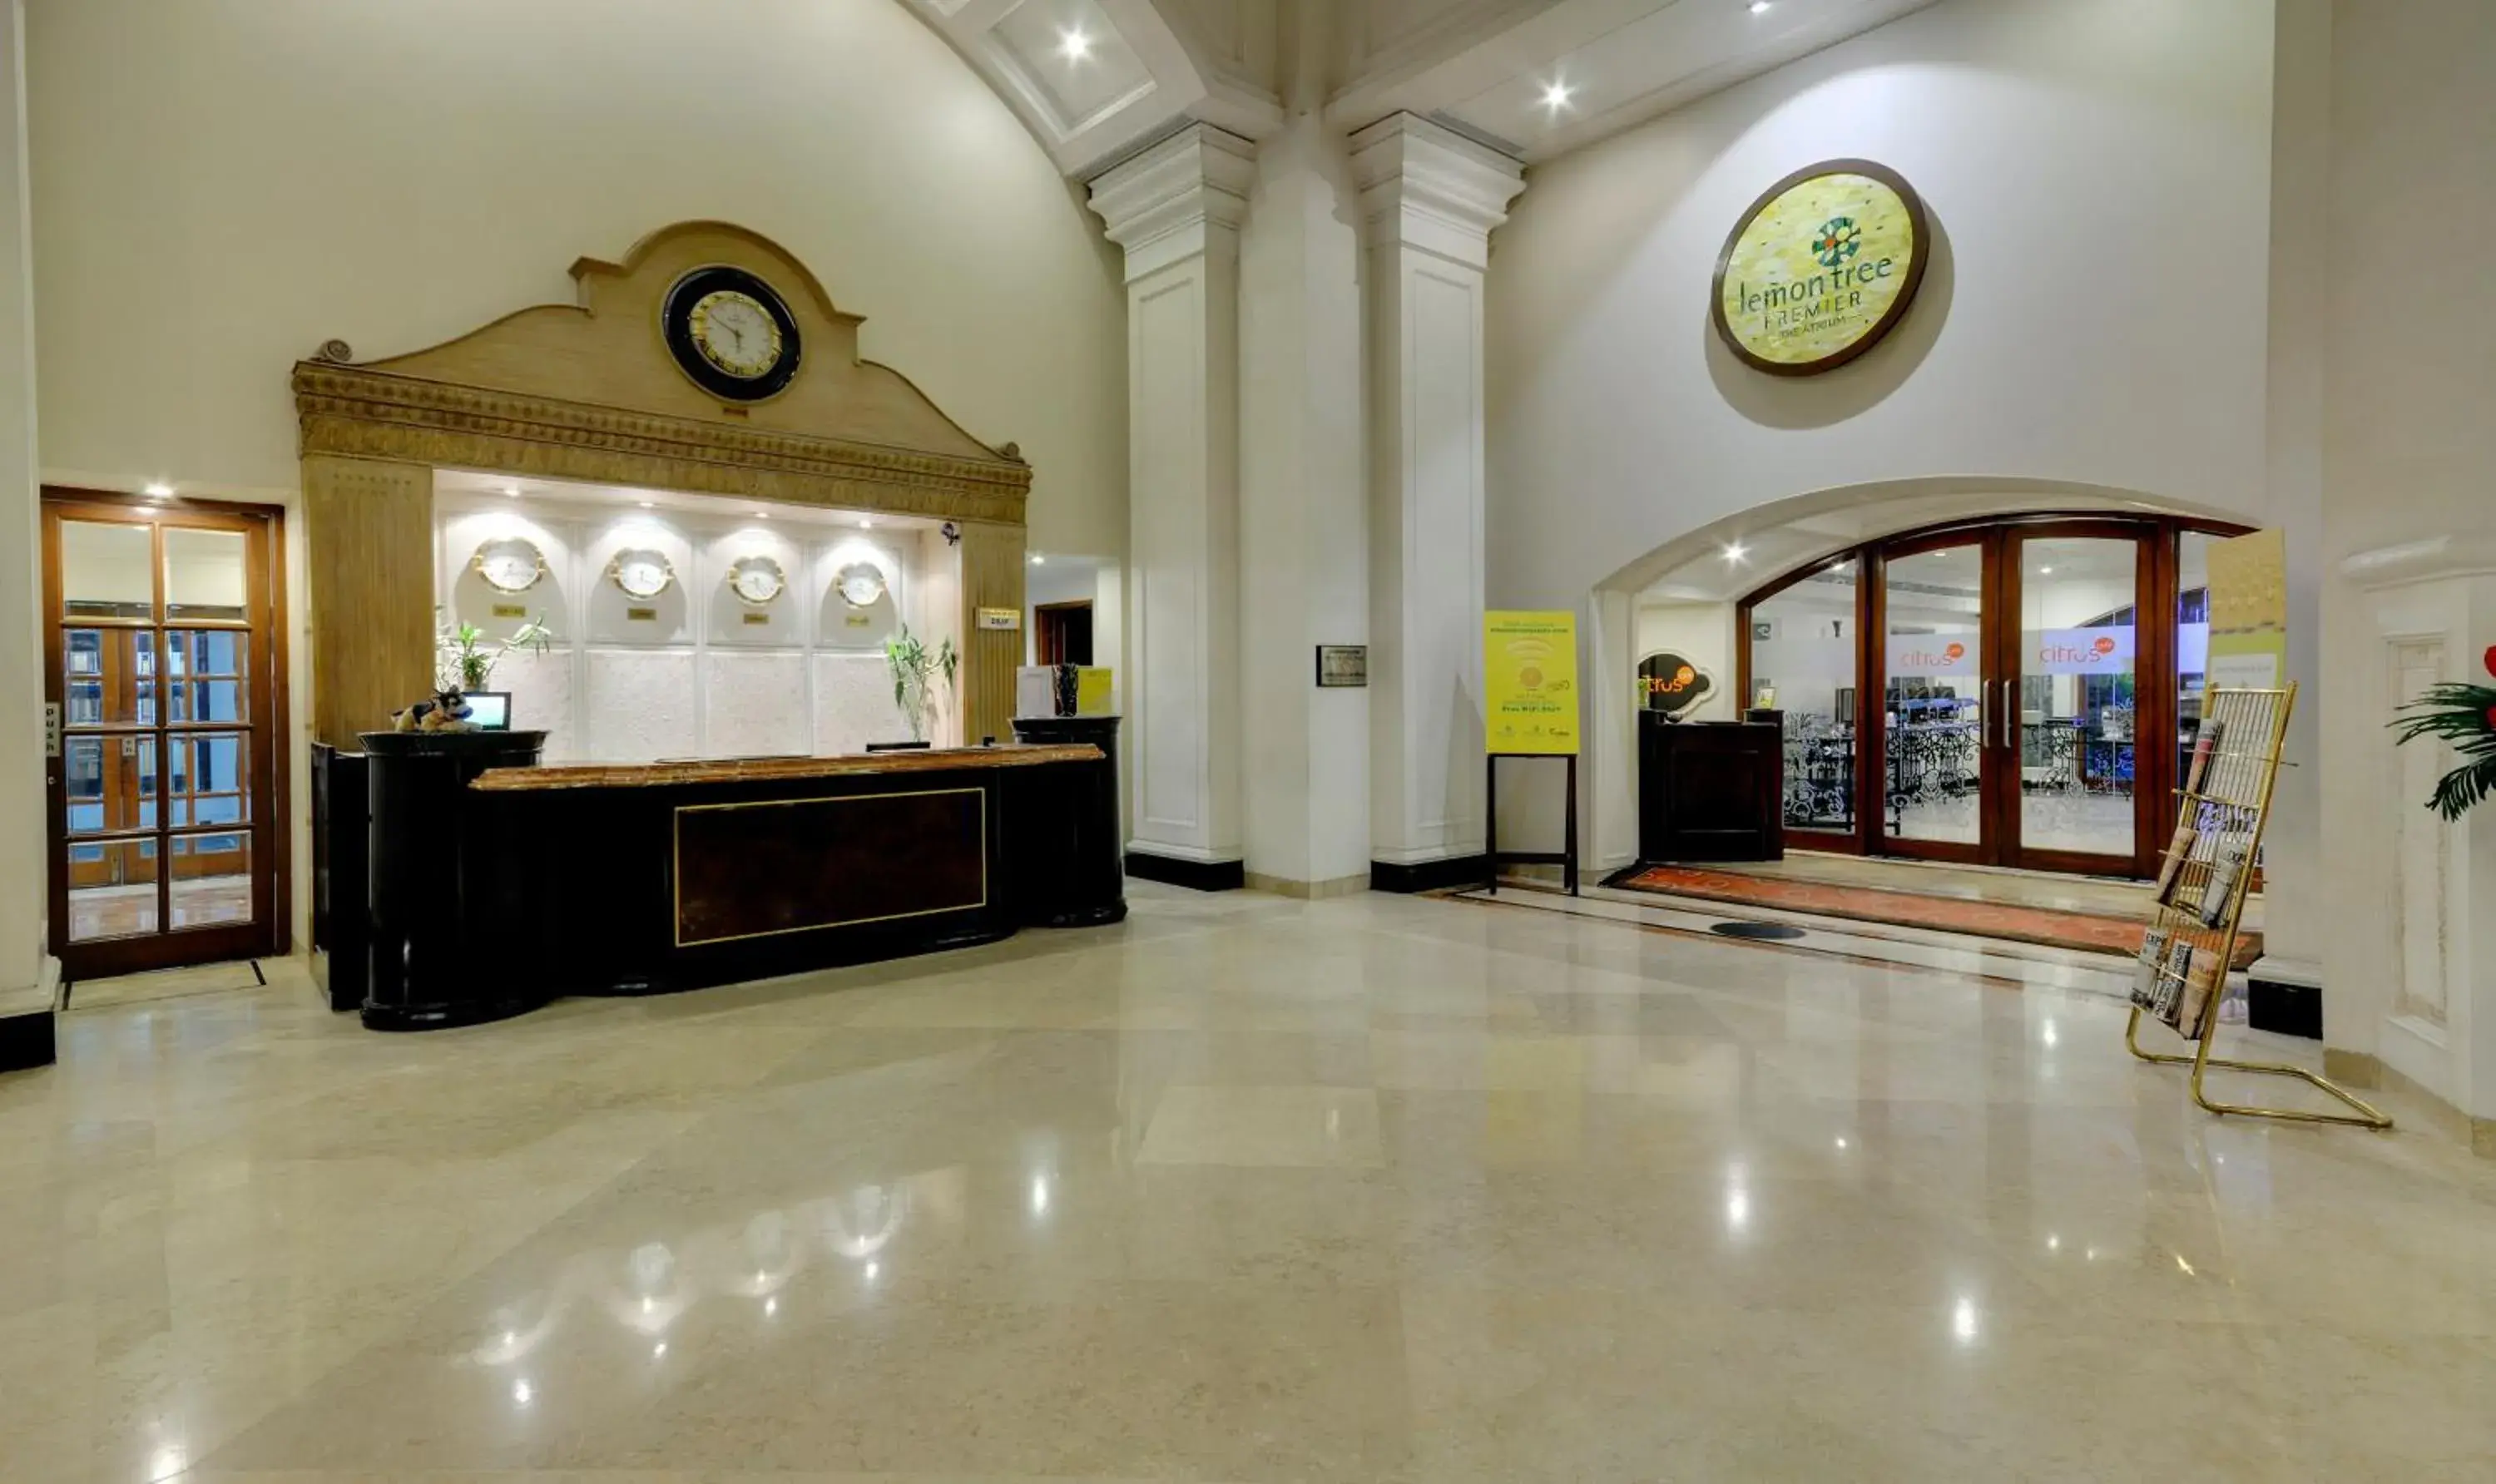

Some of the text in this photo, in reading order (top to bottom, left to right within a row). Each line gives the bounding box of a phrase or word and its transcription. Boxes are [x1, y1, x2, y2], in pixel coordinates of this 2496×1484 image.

[1738, 257, 1893, 314] lemon tree
[1763, 290, 1862, 330] PREMIER
[1900, 650, 1953, 666] citrus
[2039, 643, 2102, 664] citrus
[1641, 675, 1684, 693] trus
